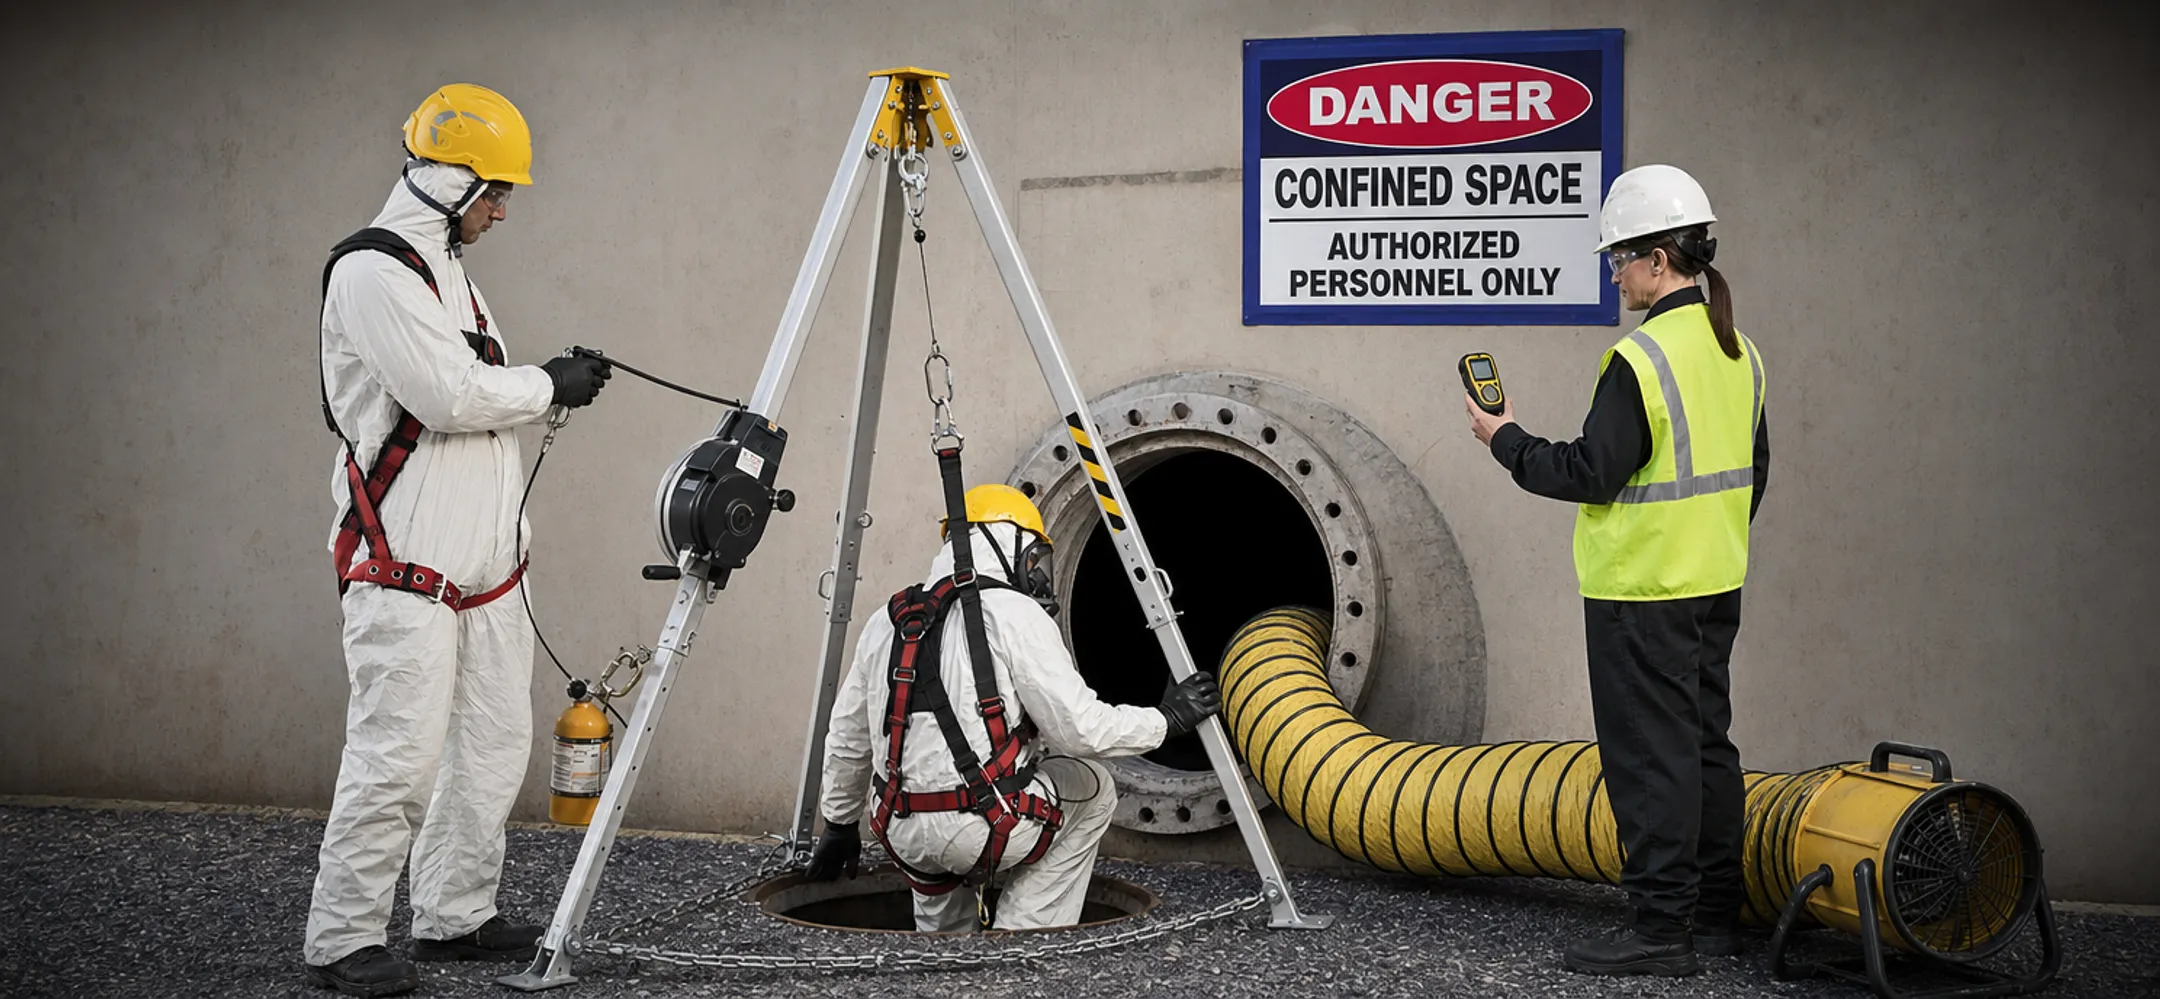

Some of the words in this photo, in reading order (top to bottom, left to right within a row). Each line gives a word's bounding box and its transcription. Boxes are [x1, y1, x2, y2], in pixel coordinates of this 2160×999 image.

[1309, 80, 1555, 126] DANGER
[1274, 166, 1453, 209] CONFINED
[1464, 162, 1582, 205] SPACE
[1327, 230, 1520, 260] AUTHORIZED
[1290, 268, 1473, 297] PERSONNEL
[1481, 267, 1561, 296] ONLY
